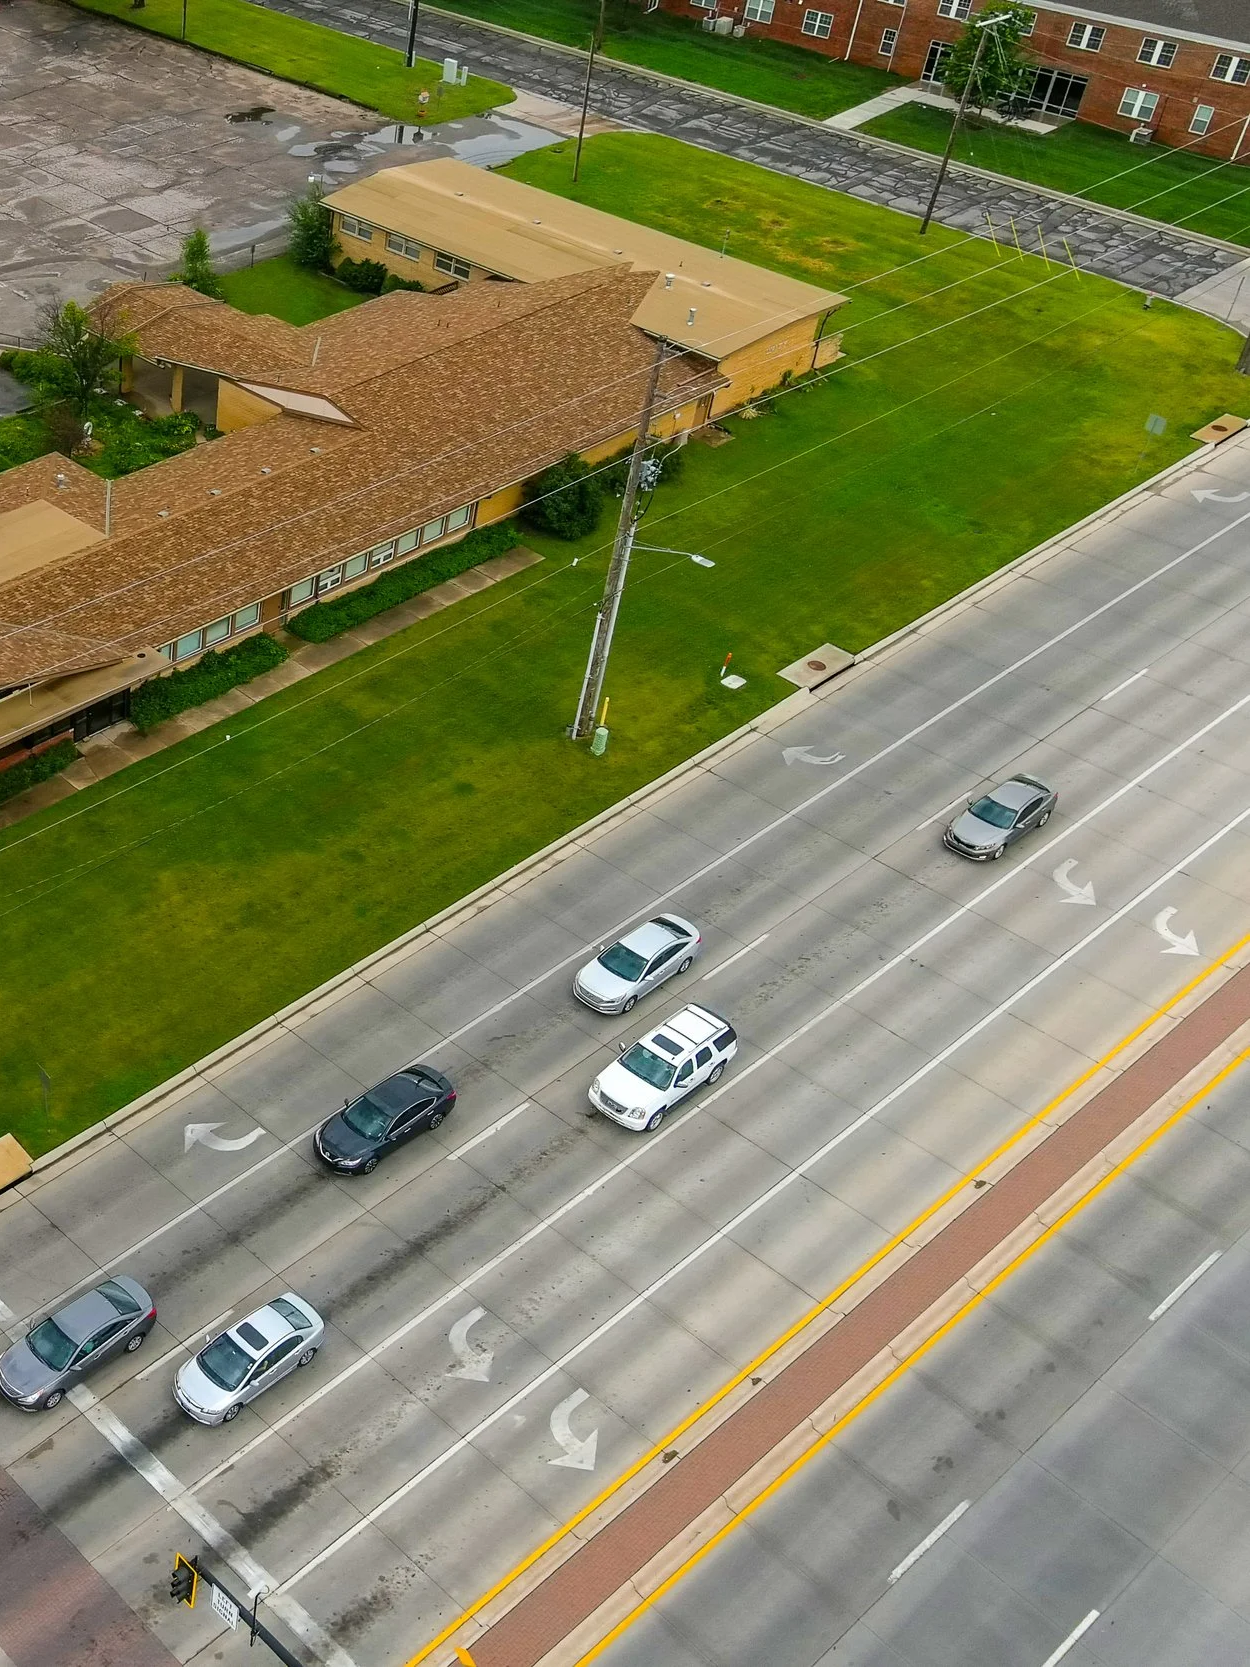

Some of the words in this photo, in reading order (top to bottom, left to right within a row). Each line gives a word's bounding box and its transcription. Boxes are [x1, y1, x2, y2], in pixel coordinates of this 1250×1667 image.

[217, 1592, 232, 1609] LEFT
[217, 1599, 233, 1618] TURN
[213, 1602, 235, 1626] SIGNAL
